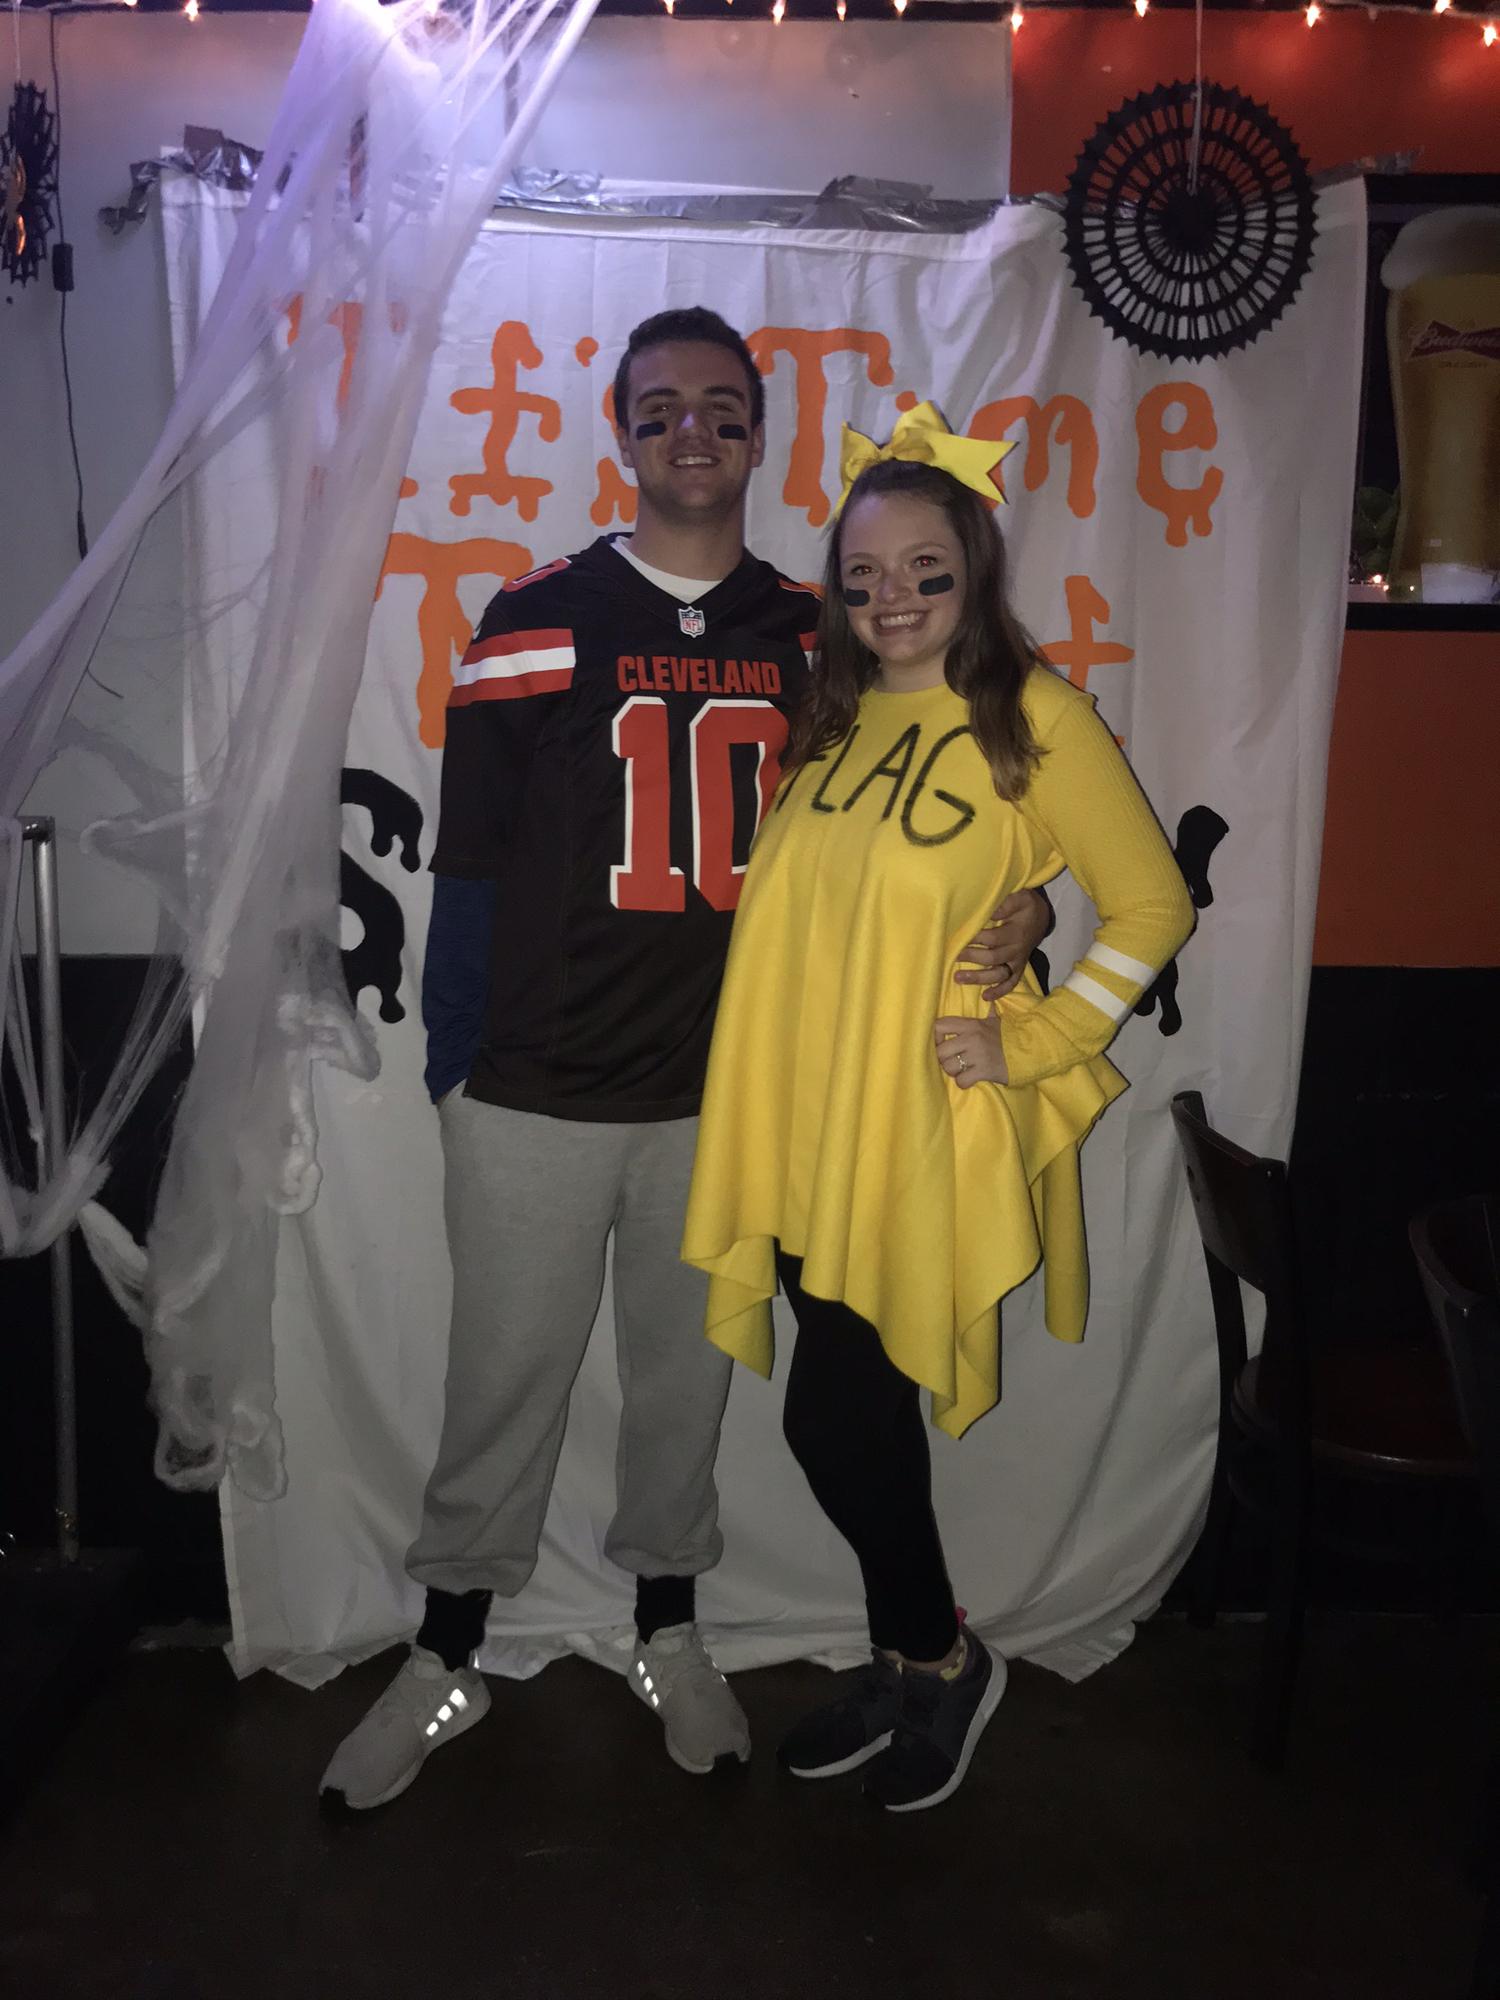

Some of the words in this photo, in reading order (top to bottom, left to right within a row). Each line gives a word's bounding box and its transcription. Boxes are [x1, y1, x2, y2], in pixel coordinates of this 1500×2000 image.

[746, 326, 1224, 547] Tme
[617, 656, 782, 694] CLEVELAND
[610, 696, 789, 912] 10
